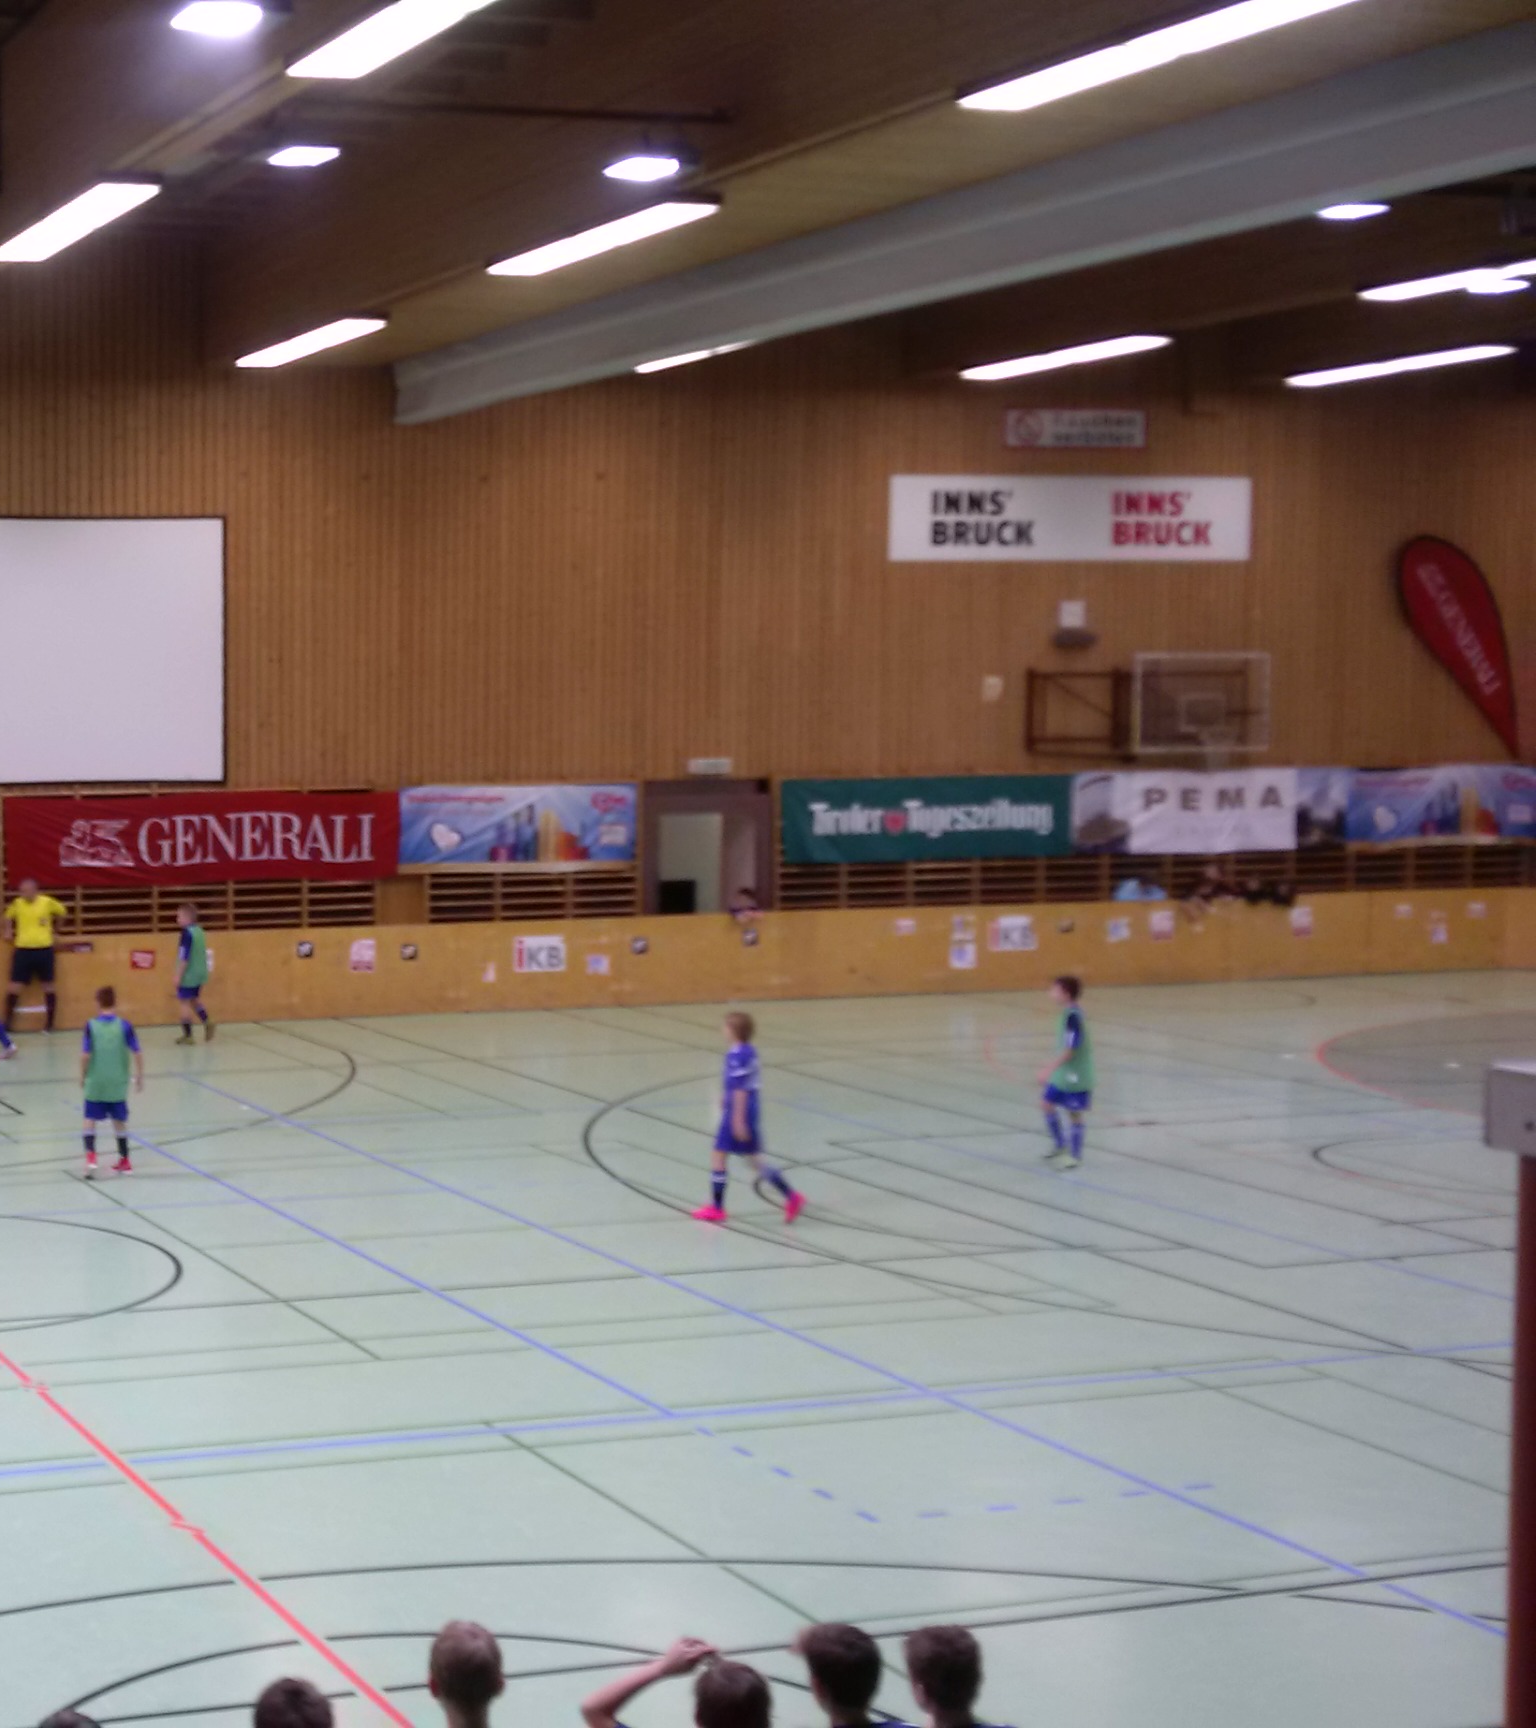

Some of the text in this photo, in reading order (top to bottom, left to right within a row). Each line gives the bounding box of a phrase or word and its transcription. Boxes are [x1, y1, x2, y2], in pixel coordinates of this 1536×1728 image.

[930, 519, 1035, 547] BRUCK
[1111, 519, 1212, 547] BRUCK
[1142, 785, 1283, 812] PEMA
[138, 812, 375, 868] GENERALI
